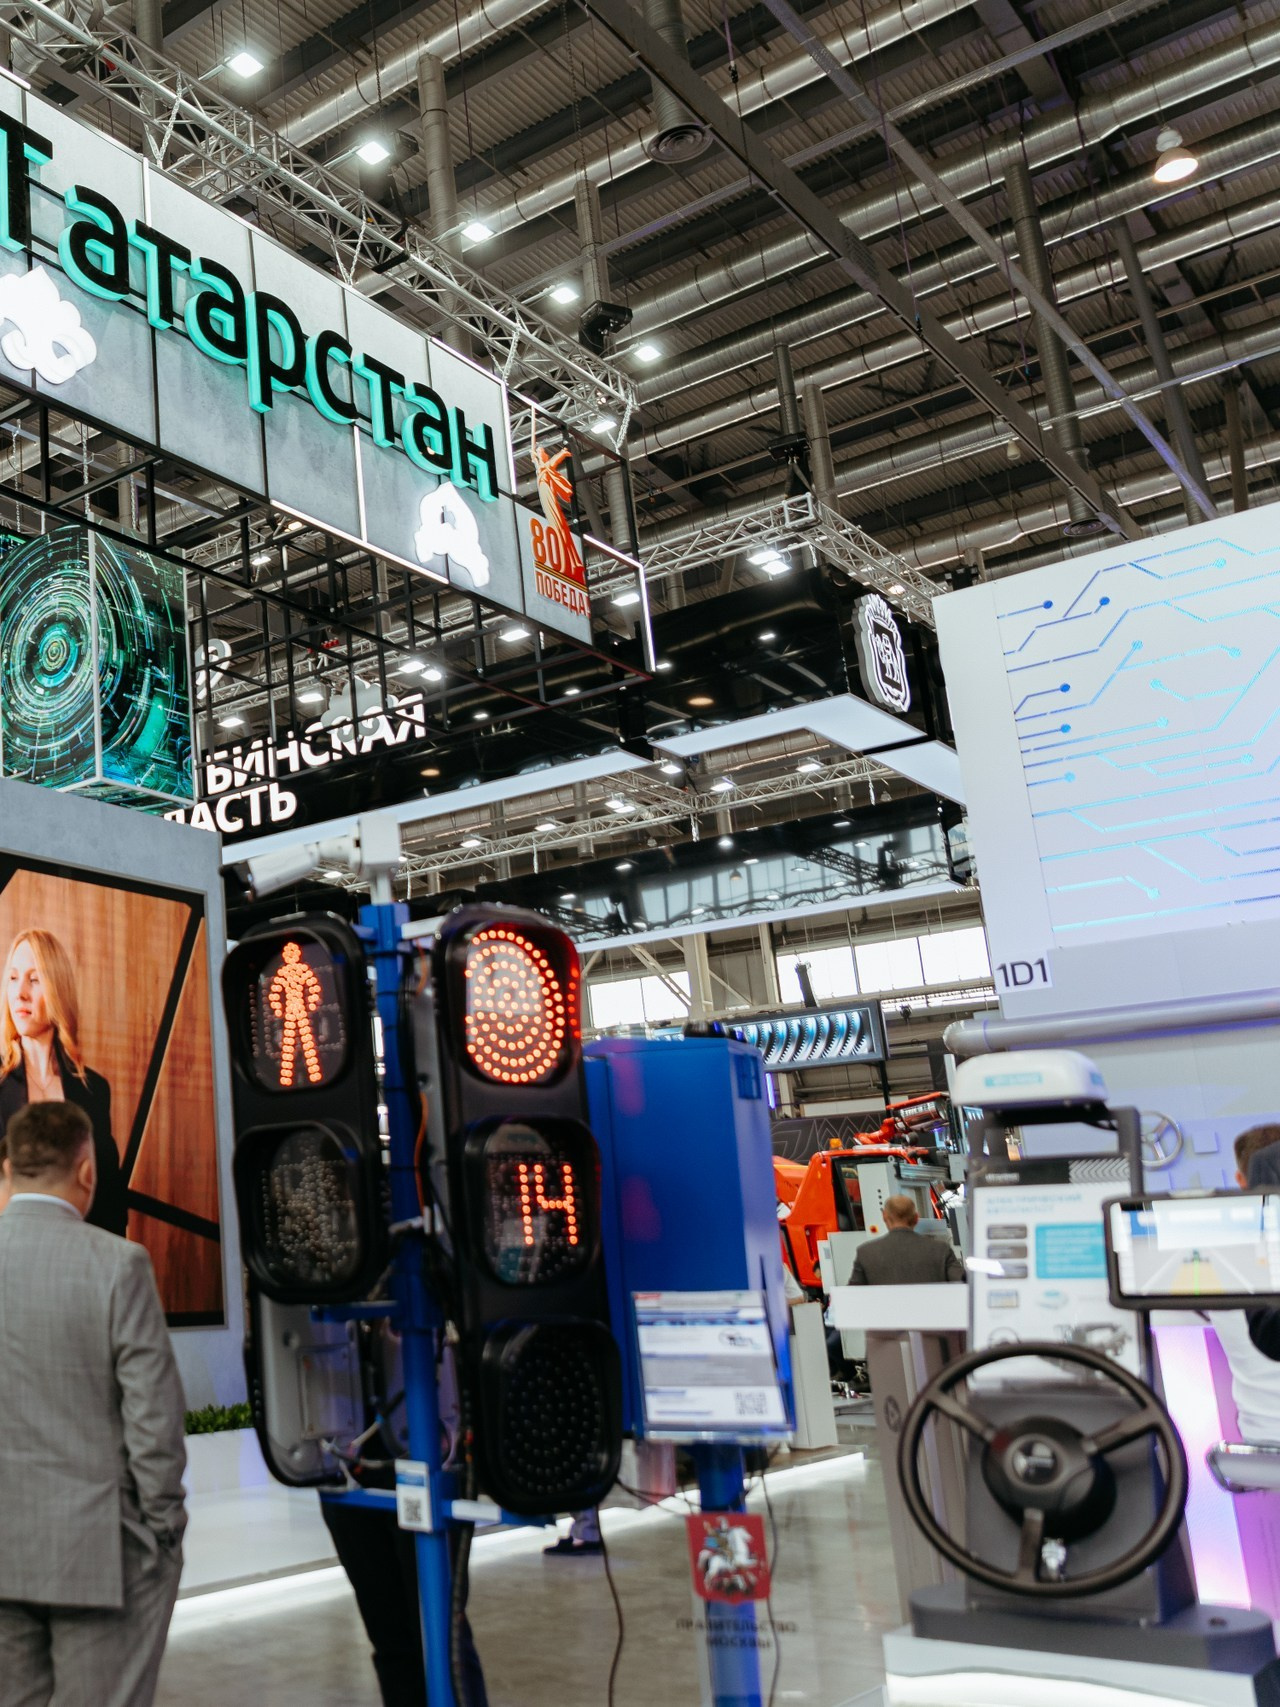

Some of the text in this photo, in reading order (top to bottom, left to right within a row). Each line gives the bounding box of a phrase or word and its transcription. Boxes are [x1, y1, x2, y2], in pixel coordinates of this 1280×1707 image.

[530, 517, 563, 573] 80
[206, 692, 426, 796] БИНСКАЯ
[996, 957, 1048, 987] 1D1
[519, 1163, 578, 1245] 14
